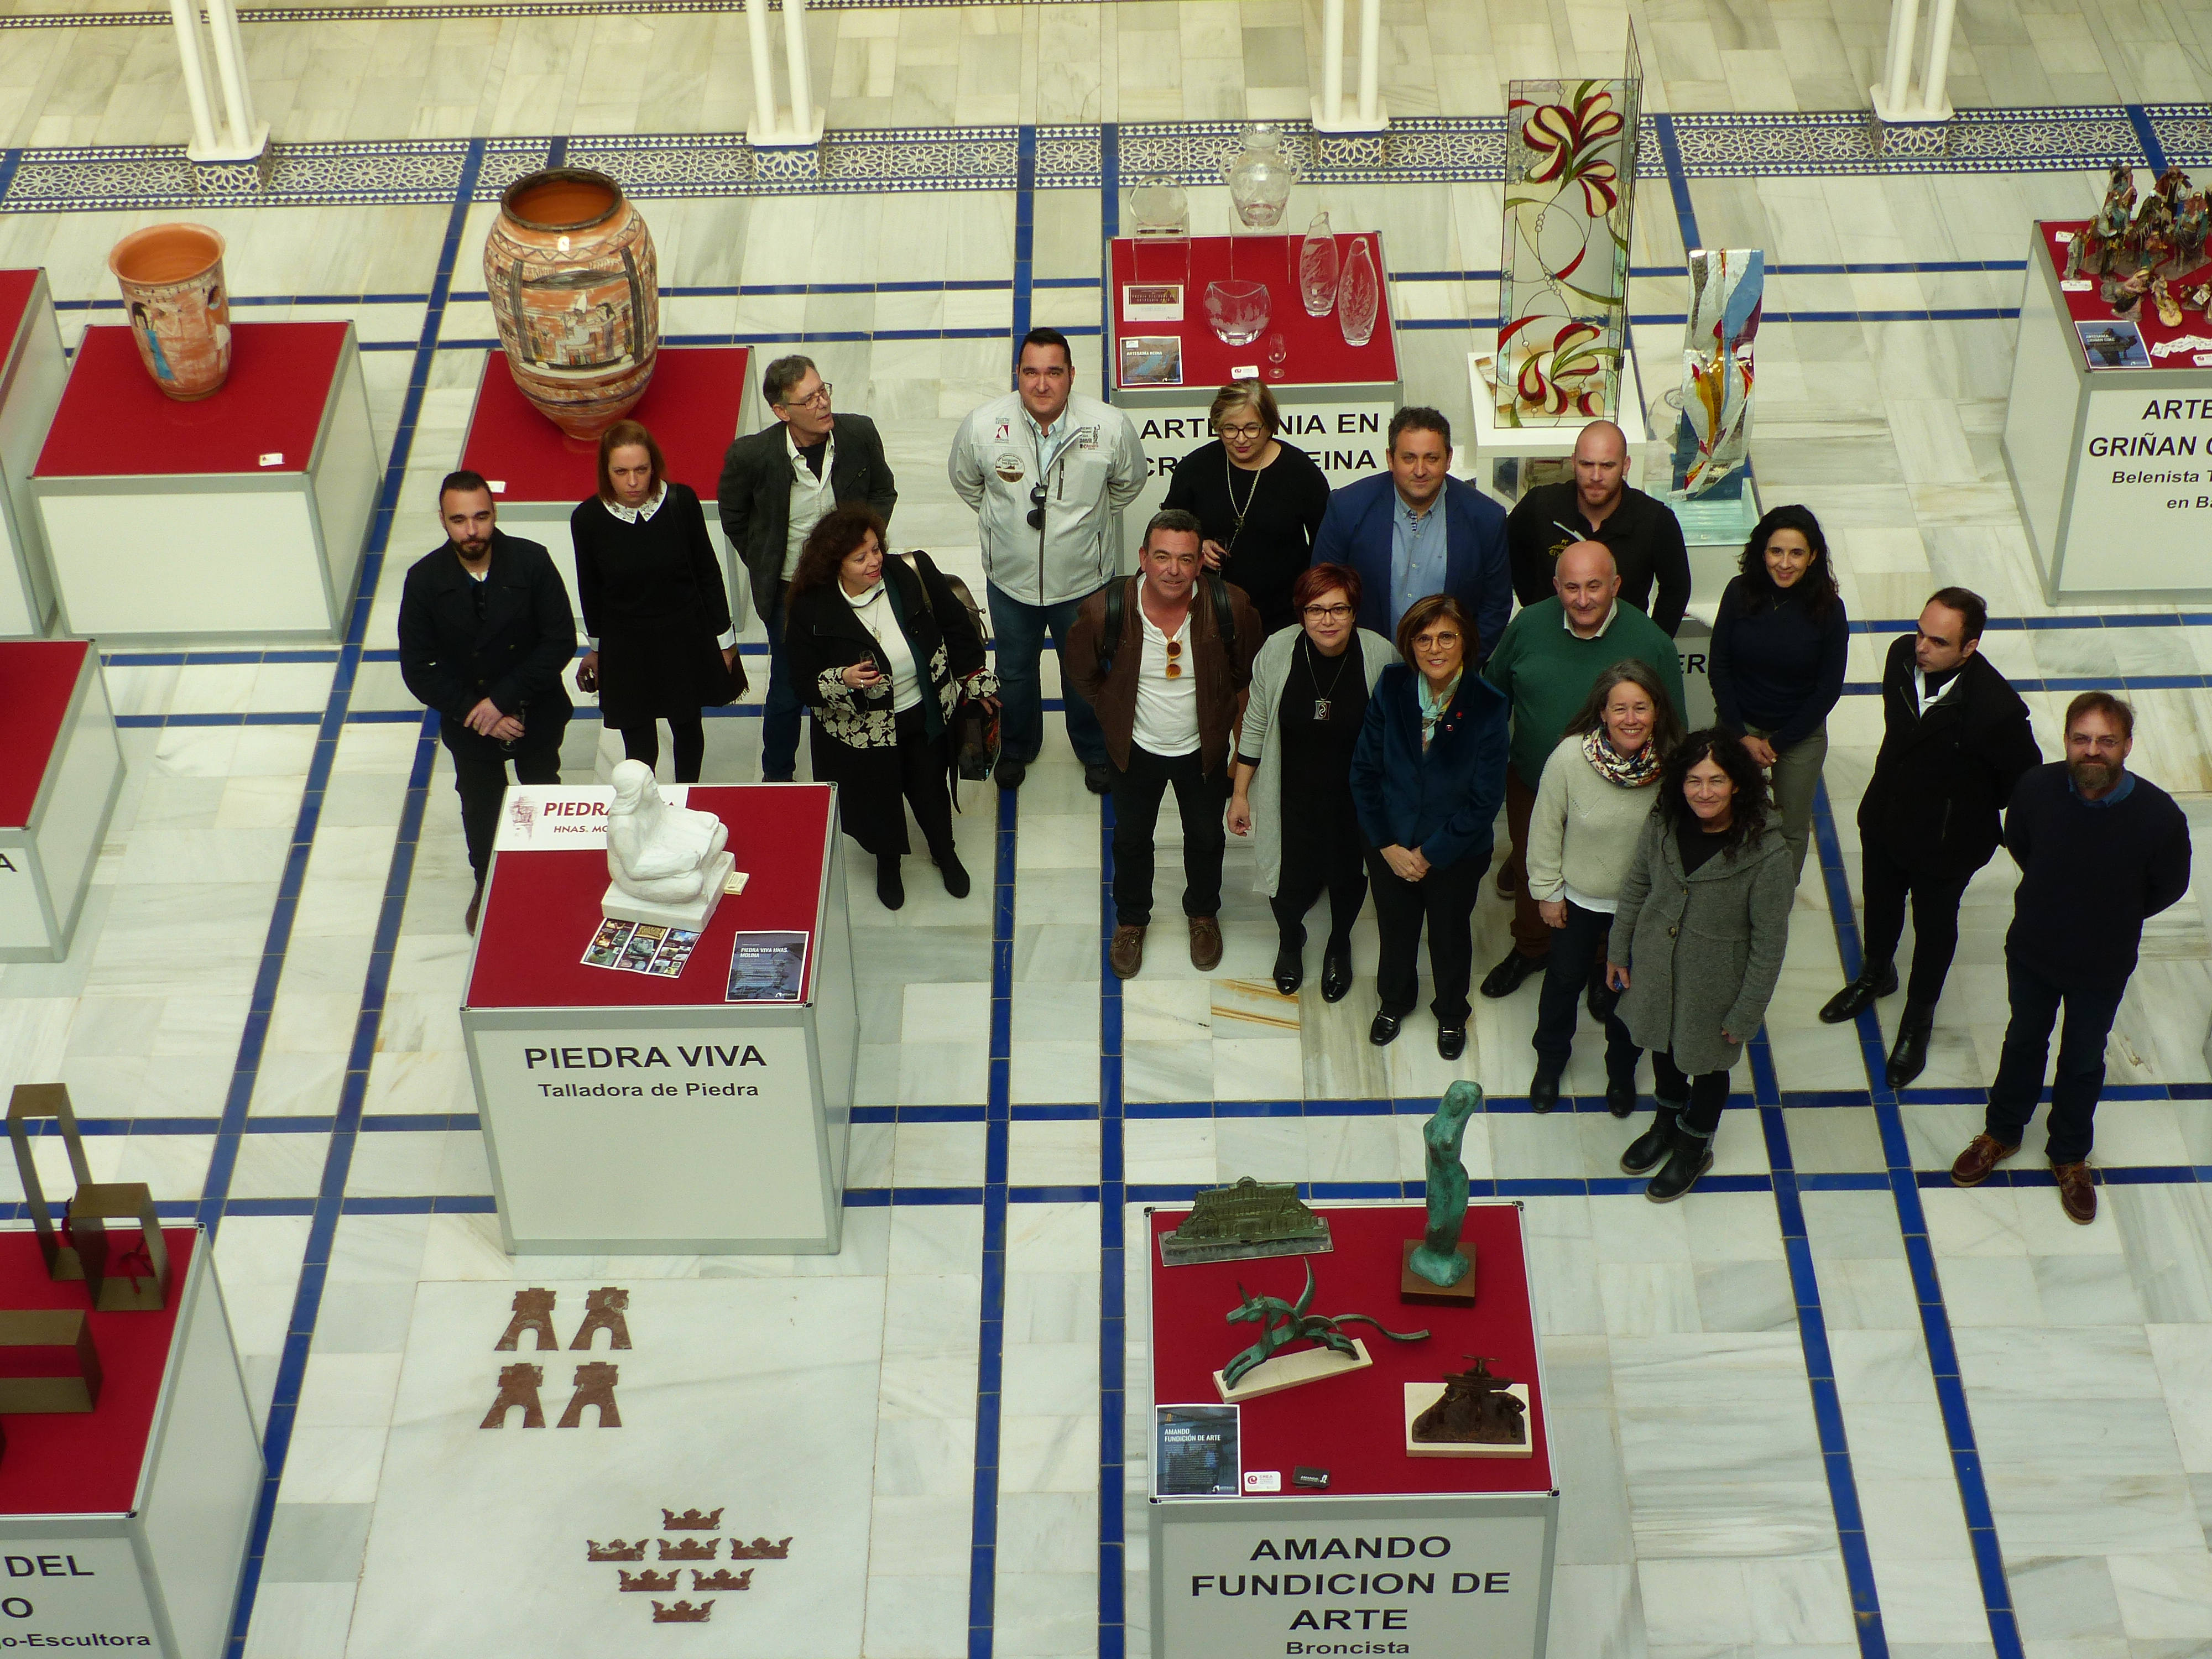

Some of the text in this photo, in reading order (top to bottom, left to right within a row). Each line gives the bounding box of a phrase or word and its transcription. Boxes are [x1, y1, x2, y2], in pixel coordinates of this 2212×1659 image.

[1140, 413, 1379, 440] ARTENIA EN
[2089, 432, 2197, 457] GRIÑAN
[2112, 471, 2199, 484] Belenista
[2167, 499, 2189, 509] en
[544, 802, 610, 816] PIEDR
[525, 1045, 767, 1069] PIEDRA VIVA
[538, 1082, 759, 1097] Talladora de Piedra
[1249, 1536, 1451, 1561] AMANDO
[4, 1555, 95, 1577] DEL
[1192, 1572, 1510, 1596] FUNDICION DE
[1289, 1609, 1407, 1630] ARTE
[0, 1634, 151, 1649] o-Escultora
[1286, 1641, 1409, 1654] Broncista
